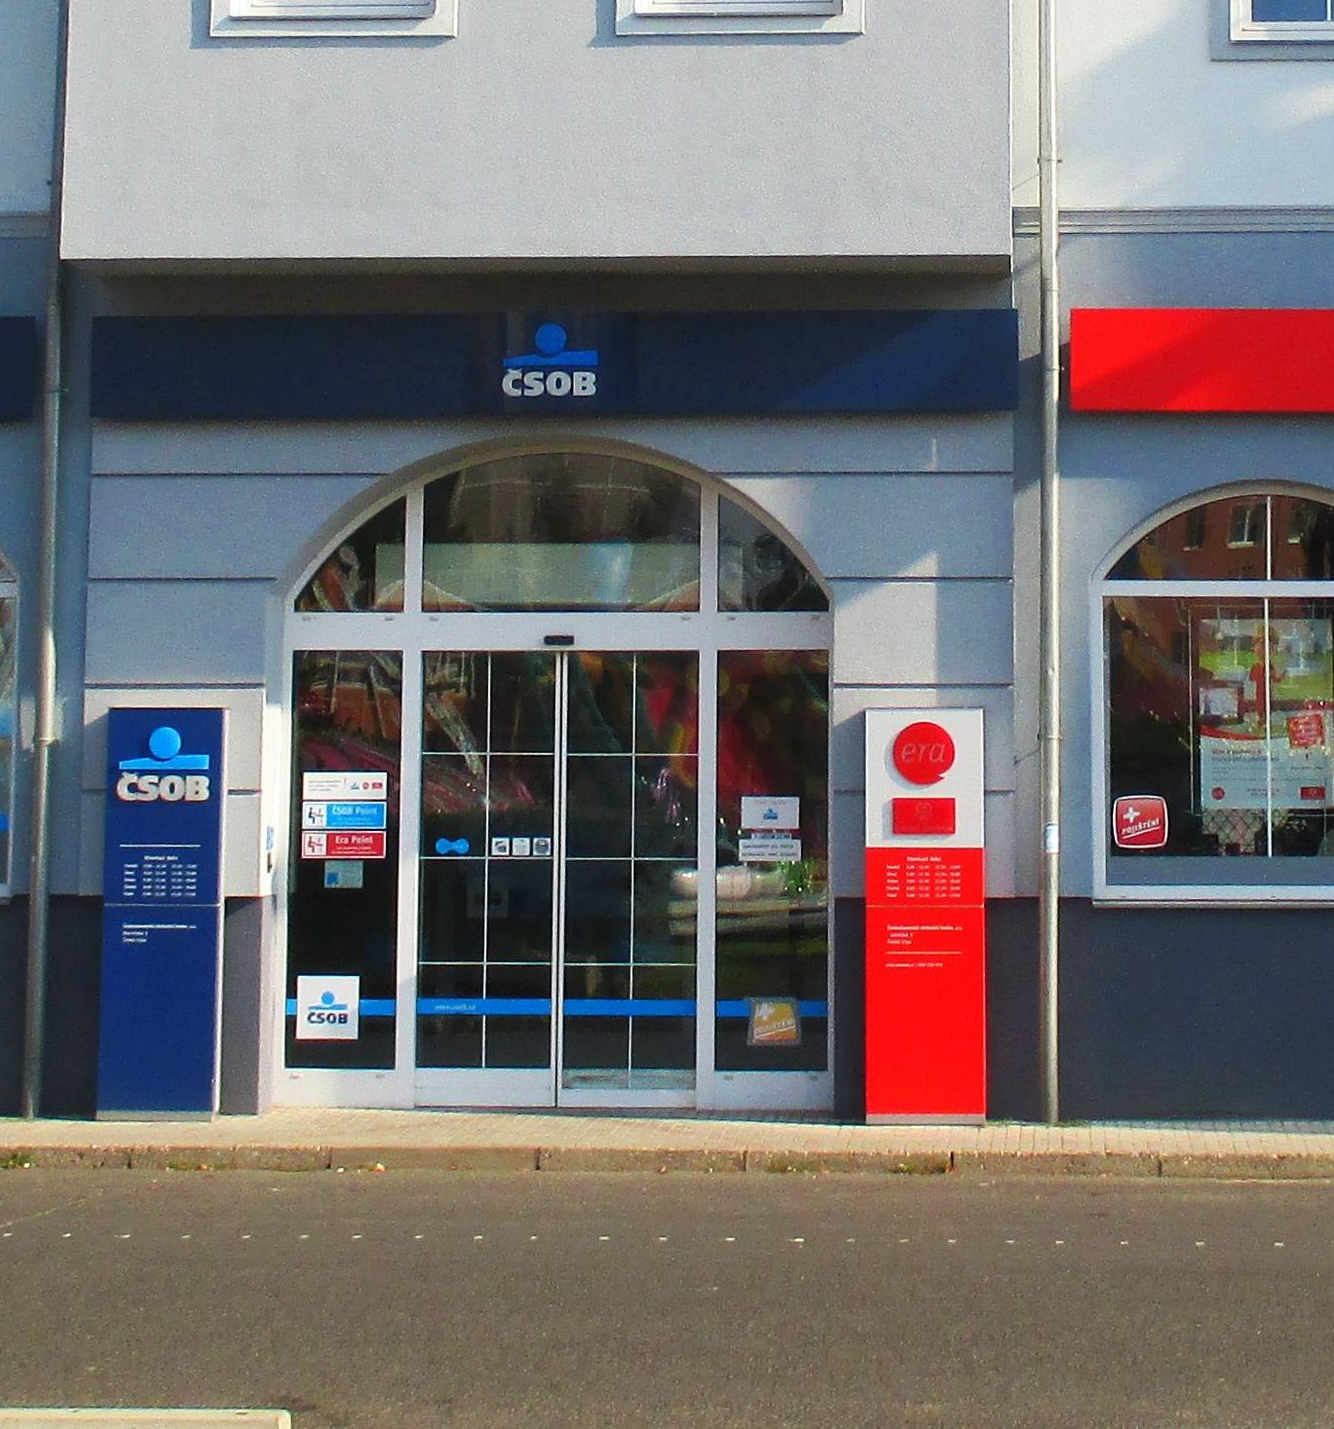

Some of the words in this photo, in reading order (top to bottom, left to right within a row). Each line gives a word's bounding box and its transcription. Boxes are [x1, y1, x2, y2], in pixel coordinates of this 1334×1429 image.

[501, 368, 597, 397] ČSOB
[900, 742, 946, 764] era
[116, 771, 210, 802] ČSOB
[351, 835, 373, 845] Point
[306, 1011, 349, 1025] ČSOB
